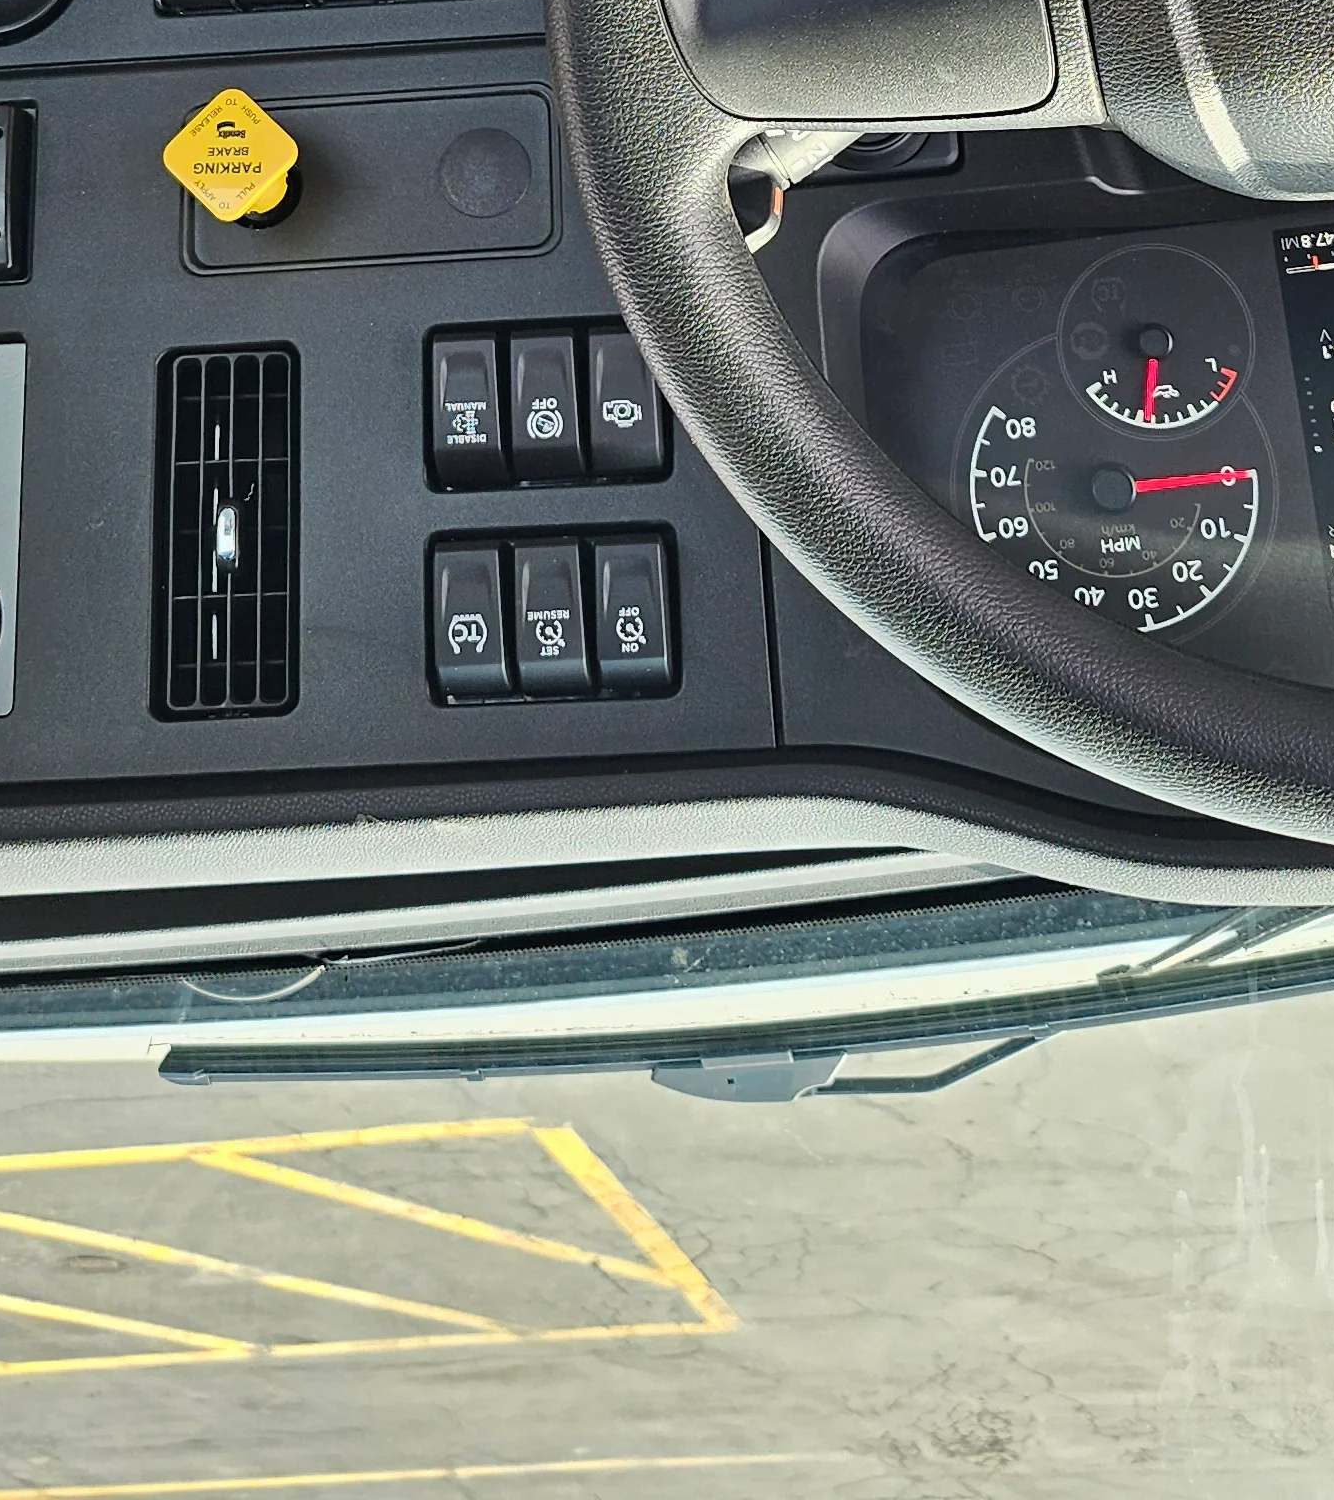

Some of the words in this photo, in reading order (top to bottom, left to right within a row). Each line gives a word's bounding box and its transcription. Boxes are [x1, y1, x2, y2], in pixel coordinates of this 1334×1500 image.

[225, 98, 237, 106] TO
[189, 106, 223, 137] RELEASE
[241, 105, 261, 125] PUSH
[207, 146, 249, 156] BRAKE
[193, 162, 262, 174] PARKING
[193, 180, 216, 201] APPLY
[235, 182, 255, 200] PULL
[219, 202, 231, 210] TO
[1319, 328, 1331, 342] V
[1205, 358, 1217, 371] L
[1102, 370, 1117, 384] H
[445, 400, 487, 412] MANUAL
[531, 398, 557, 409] OFF
[1005, 416, 1037, 438] 80
[446, 433, 487, 444] DISABLE
[1035, 460, 1055, 472] 120
[990, 466, 1021, 486] 70
[1221, 466, 1235, 486] 0
[1035, 502, 1056, 513] 100
[998, 517, 1029, 538] 60
[1169, 517, 1185, 528] 20
[1200, 518, 1231, 539] 10
[1101, 524, 1135, 537] km/h
[1059, 538, 1075, 549] 80
[1100, 536, 1141, 554] MPH
[1142, 550, 1157, 560] 40
[1099, 558, 1115, 568] 60
[1028, 560, 1059, 580] 50
[1172, 560, 1203, 581] 20
[1074, 586, 1105, 606] 40
[1127, 588, 1159, 608] 30
[527, 609, 569, 621] RESUME
[619, 606, 639, 617] OFF
[454, 622, 481, 642] TC
[539, 646, 561, 656] SET
[621, 642, 639, 653] ON
